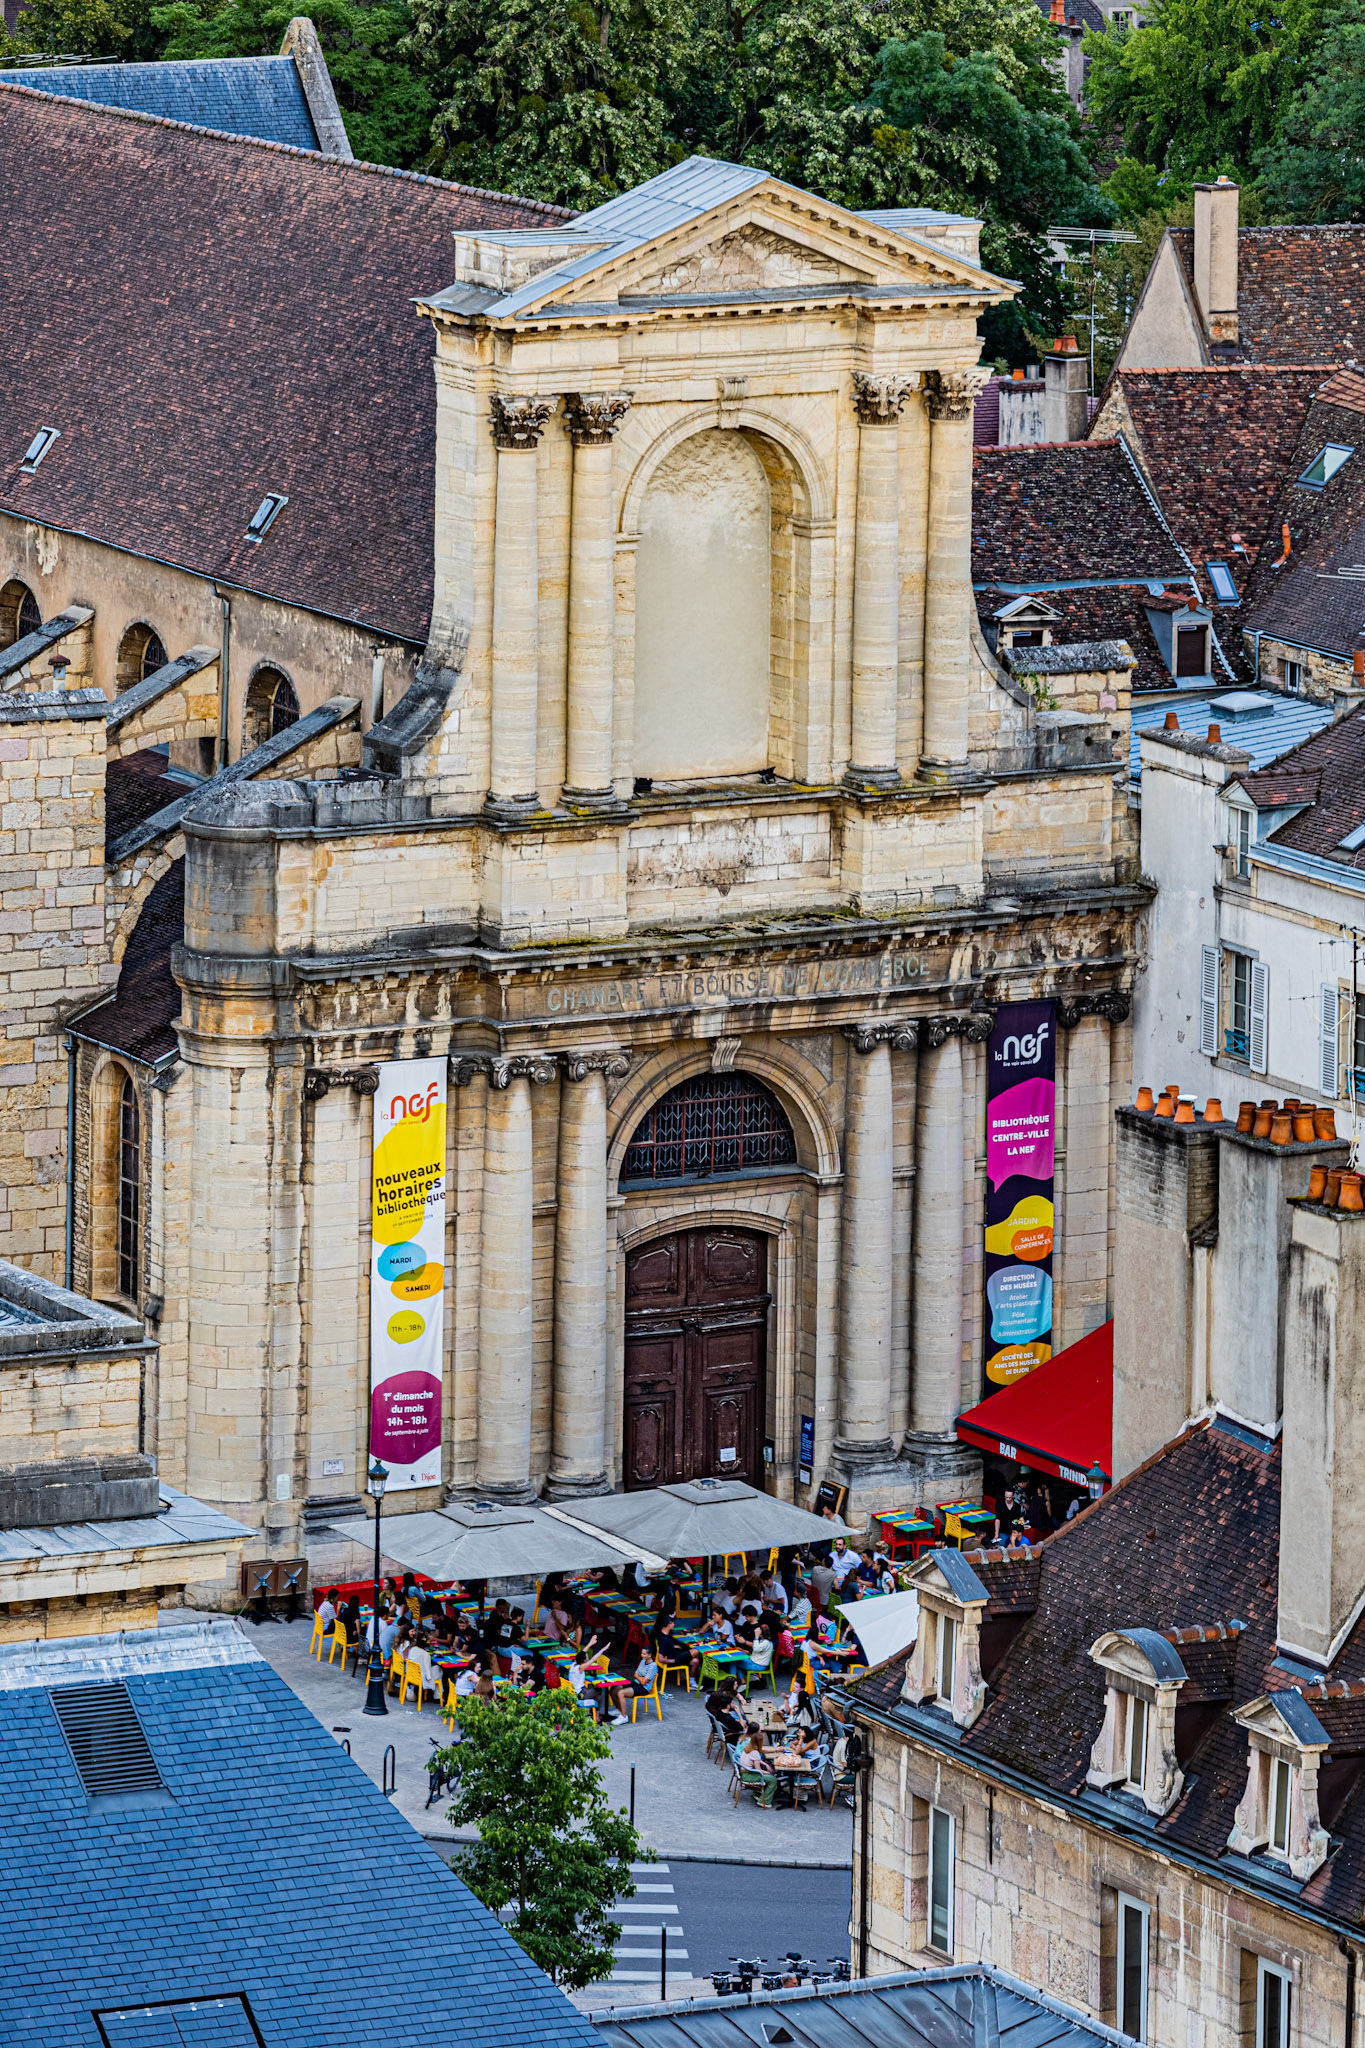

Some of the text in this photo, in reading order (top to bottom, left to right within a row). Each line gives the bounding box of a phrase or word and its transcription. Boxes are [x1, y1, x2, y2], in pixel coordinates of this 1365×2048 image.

[549, 956, 930, 1011] CHAMBRE ET BOURSE DE COMMERCE
[994, 1022, 1049, 1064] la nef
[381, 1082, 438, 1123] la nef
[992, 1114, 1050, 1128] BIBLIOTHÈQUE
[992, 1129, 1050, 1142] CENTRE-VILLE
[1007, 1145, 1036, 1156] LA NEF
[376, 1162, 442, 1188] nouveaux
[378, 1178, 442, 1203] horaires
[377, 1191, 446, 1216] bibliothèque
[1008, 1217, 1038, 1226] JARDIN
[1020, 1235, 1036, 1243] SALLE
[389, 1256, 412, 1265] MARDI
[1002, 1273, 1036, 1283] DIRECTION
[405, 1284, 431, 1292] SAMEDI
[1013, 1280, 1038, 1290] MUSÉES
[393, 1390, 434, 1401] dimanche
[391, 1404, 424, 1413] du mois
[387, 1416, 403, 1427] 14h
[411, 1415, 428, 1425] 18h
[999, 1441, 1017, 1460] BAR
